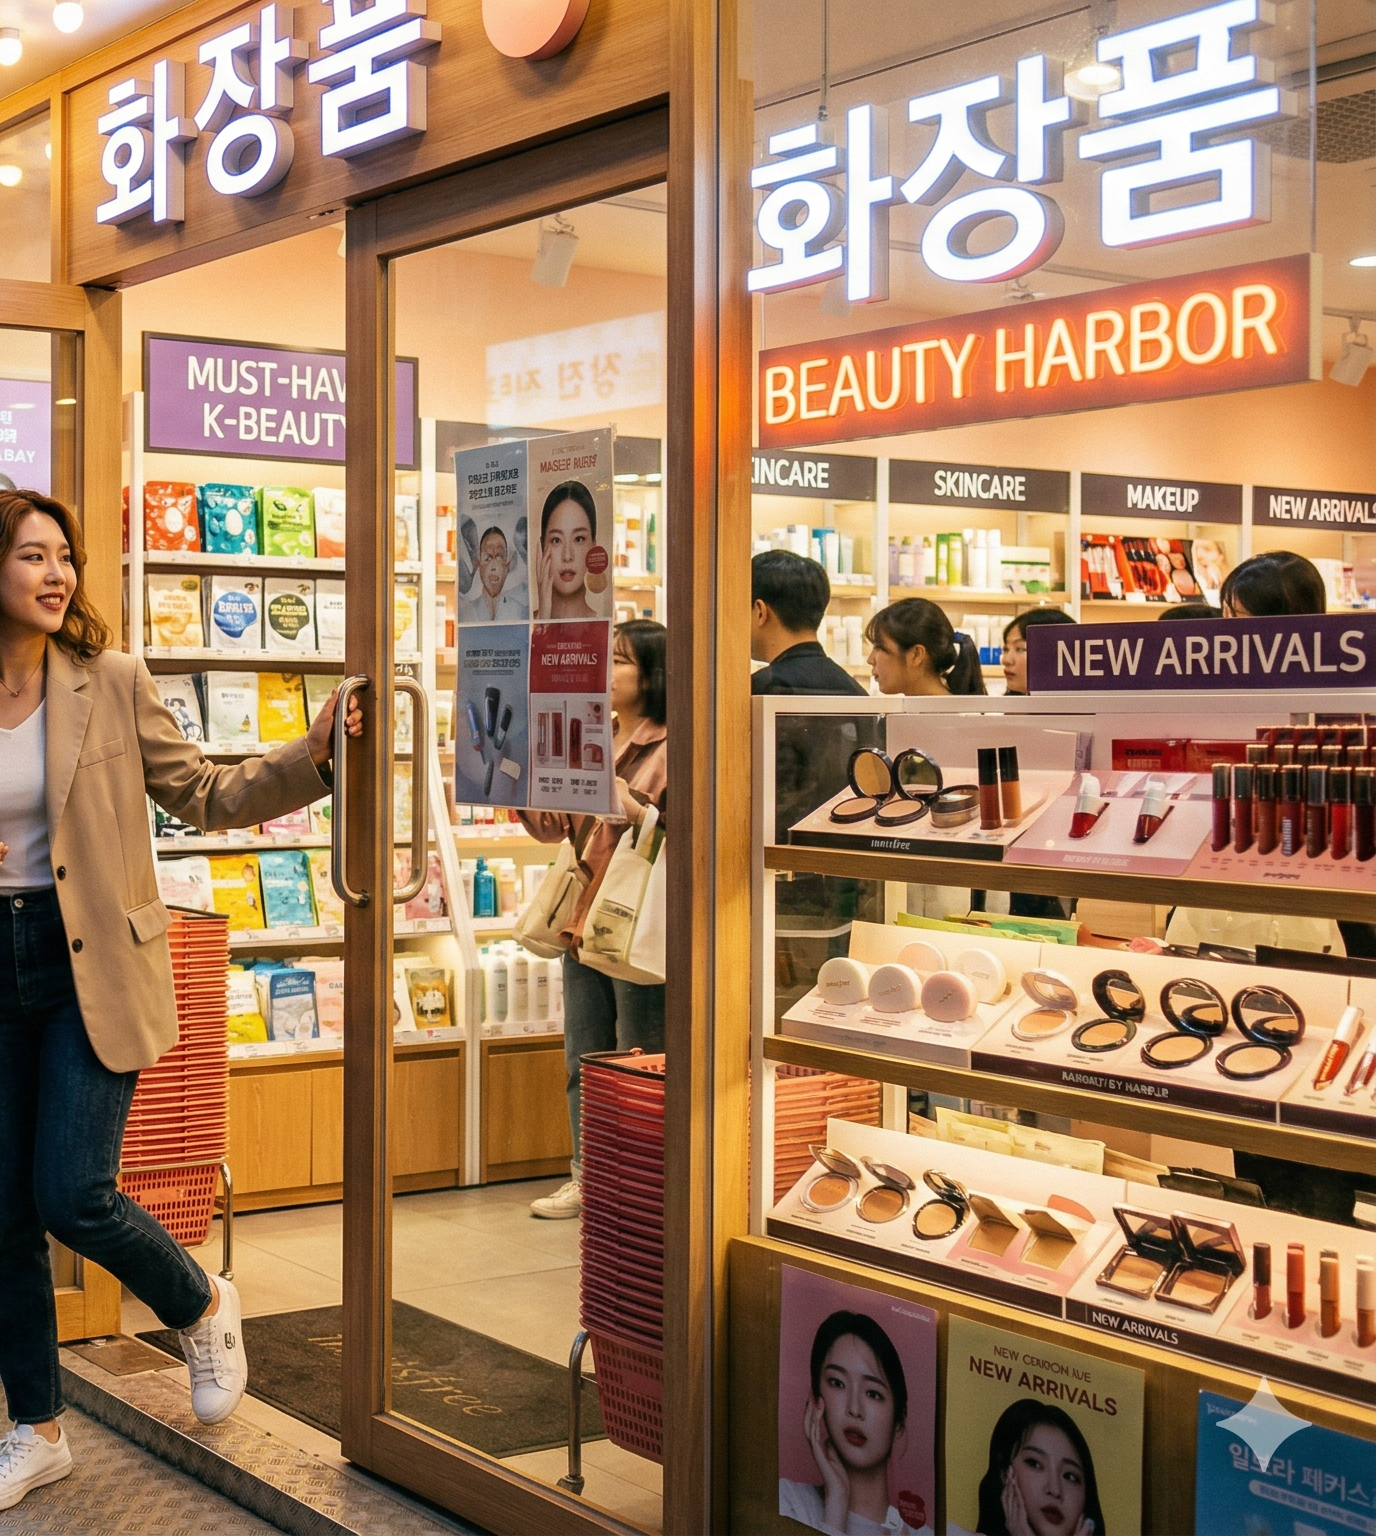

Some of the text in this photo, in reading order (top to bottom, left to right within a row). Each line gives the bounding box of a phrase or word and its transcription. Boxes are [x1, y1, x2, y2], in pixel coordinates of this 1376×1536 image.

[95, 0, 423, 226] 화장품
[746, 0, 1281, 303] 화장품
[765, 284, 1279, 425] BEAUTY HARBOR
[187, 355, 346, 403] MUST-HAV
[751, 457, 830, 489] INCARE
[933, 469, 1027, 502] SKINCARE
[1126, 484, 1200, 513] MAKEUP
[1269, 495, 1376, 523] NEW ARRIVAL
[1055, 630, 1367, 677] NEW ARRIVALS
[1091, 1311, 1179, 1345] NEW ARRIVALS
[993, 1345, 1019, 1362] NEW
[969, 1355, 1118, 1417] NEW ARRIVALS
